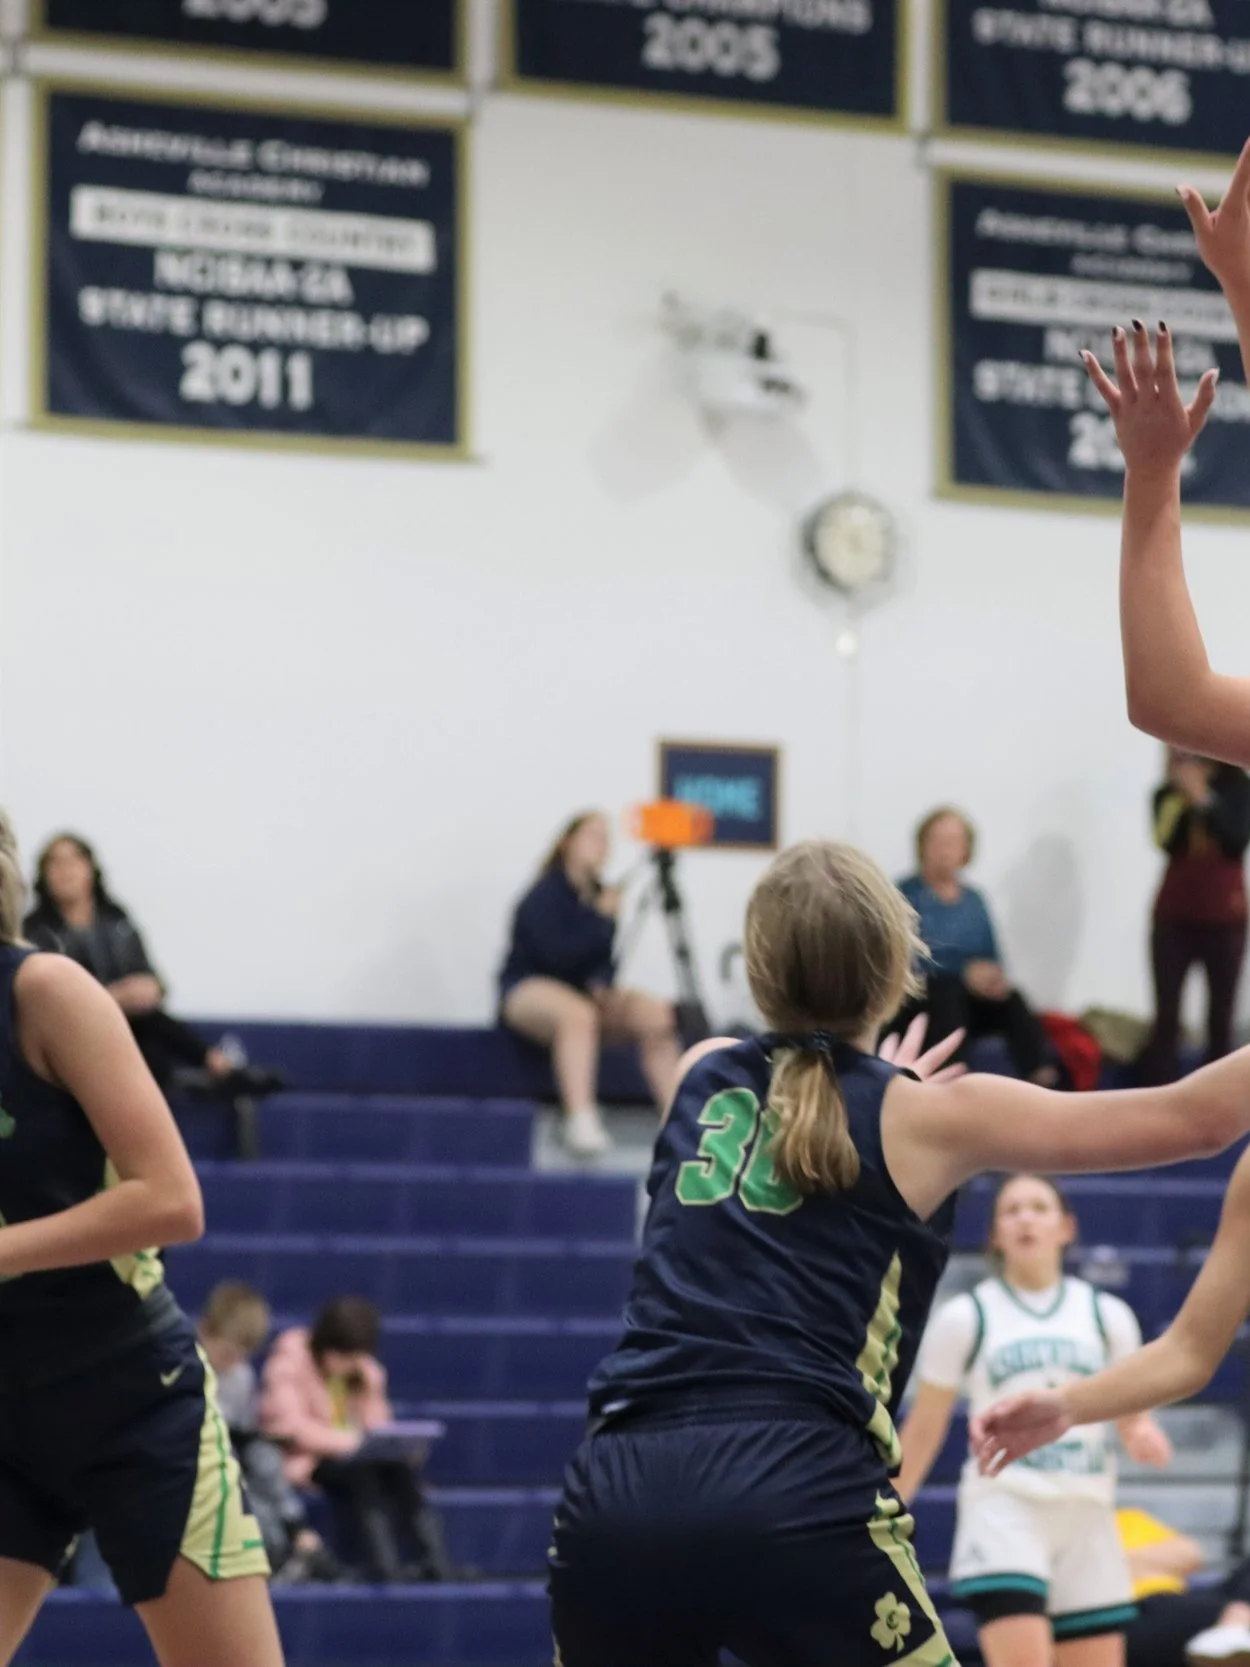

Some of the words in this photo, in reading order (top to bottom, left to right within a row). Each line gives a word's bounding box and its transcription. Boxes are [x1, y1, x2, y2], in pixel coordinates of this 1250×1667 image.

[641, 12, 781, 82] 2005
[972, 8, 1079, 53] STATE
[78, 287, 197, 336] STATE
[180, 340, 314, 410] 2011
